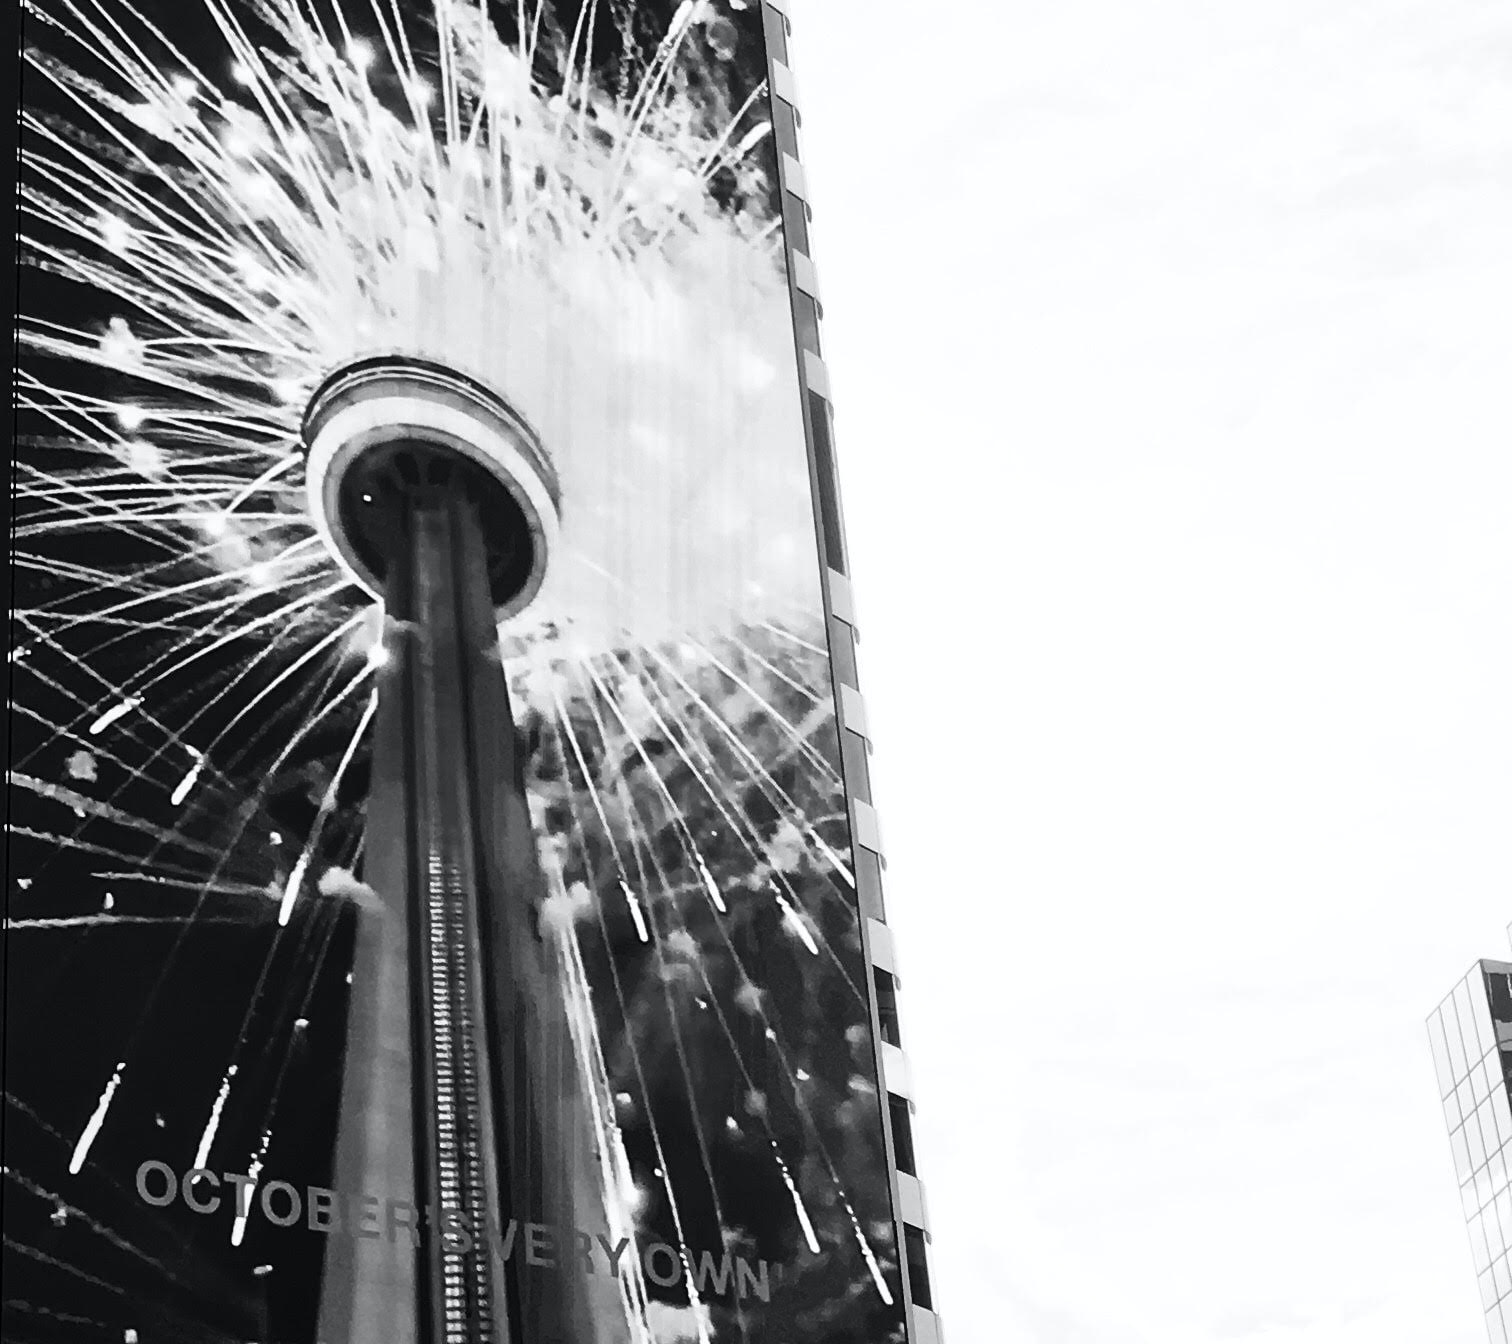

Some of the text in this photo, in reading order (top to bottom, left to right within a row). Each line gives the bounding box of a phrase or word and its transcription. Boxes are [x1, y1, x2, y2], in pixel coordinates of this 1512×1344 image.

[135, 1159, 771, 1303] OCTOBER'S VERY OWN
